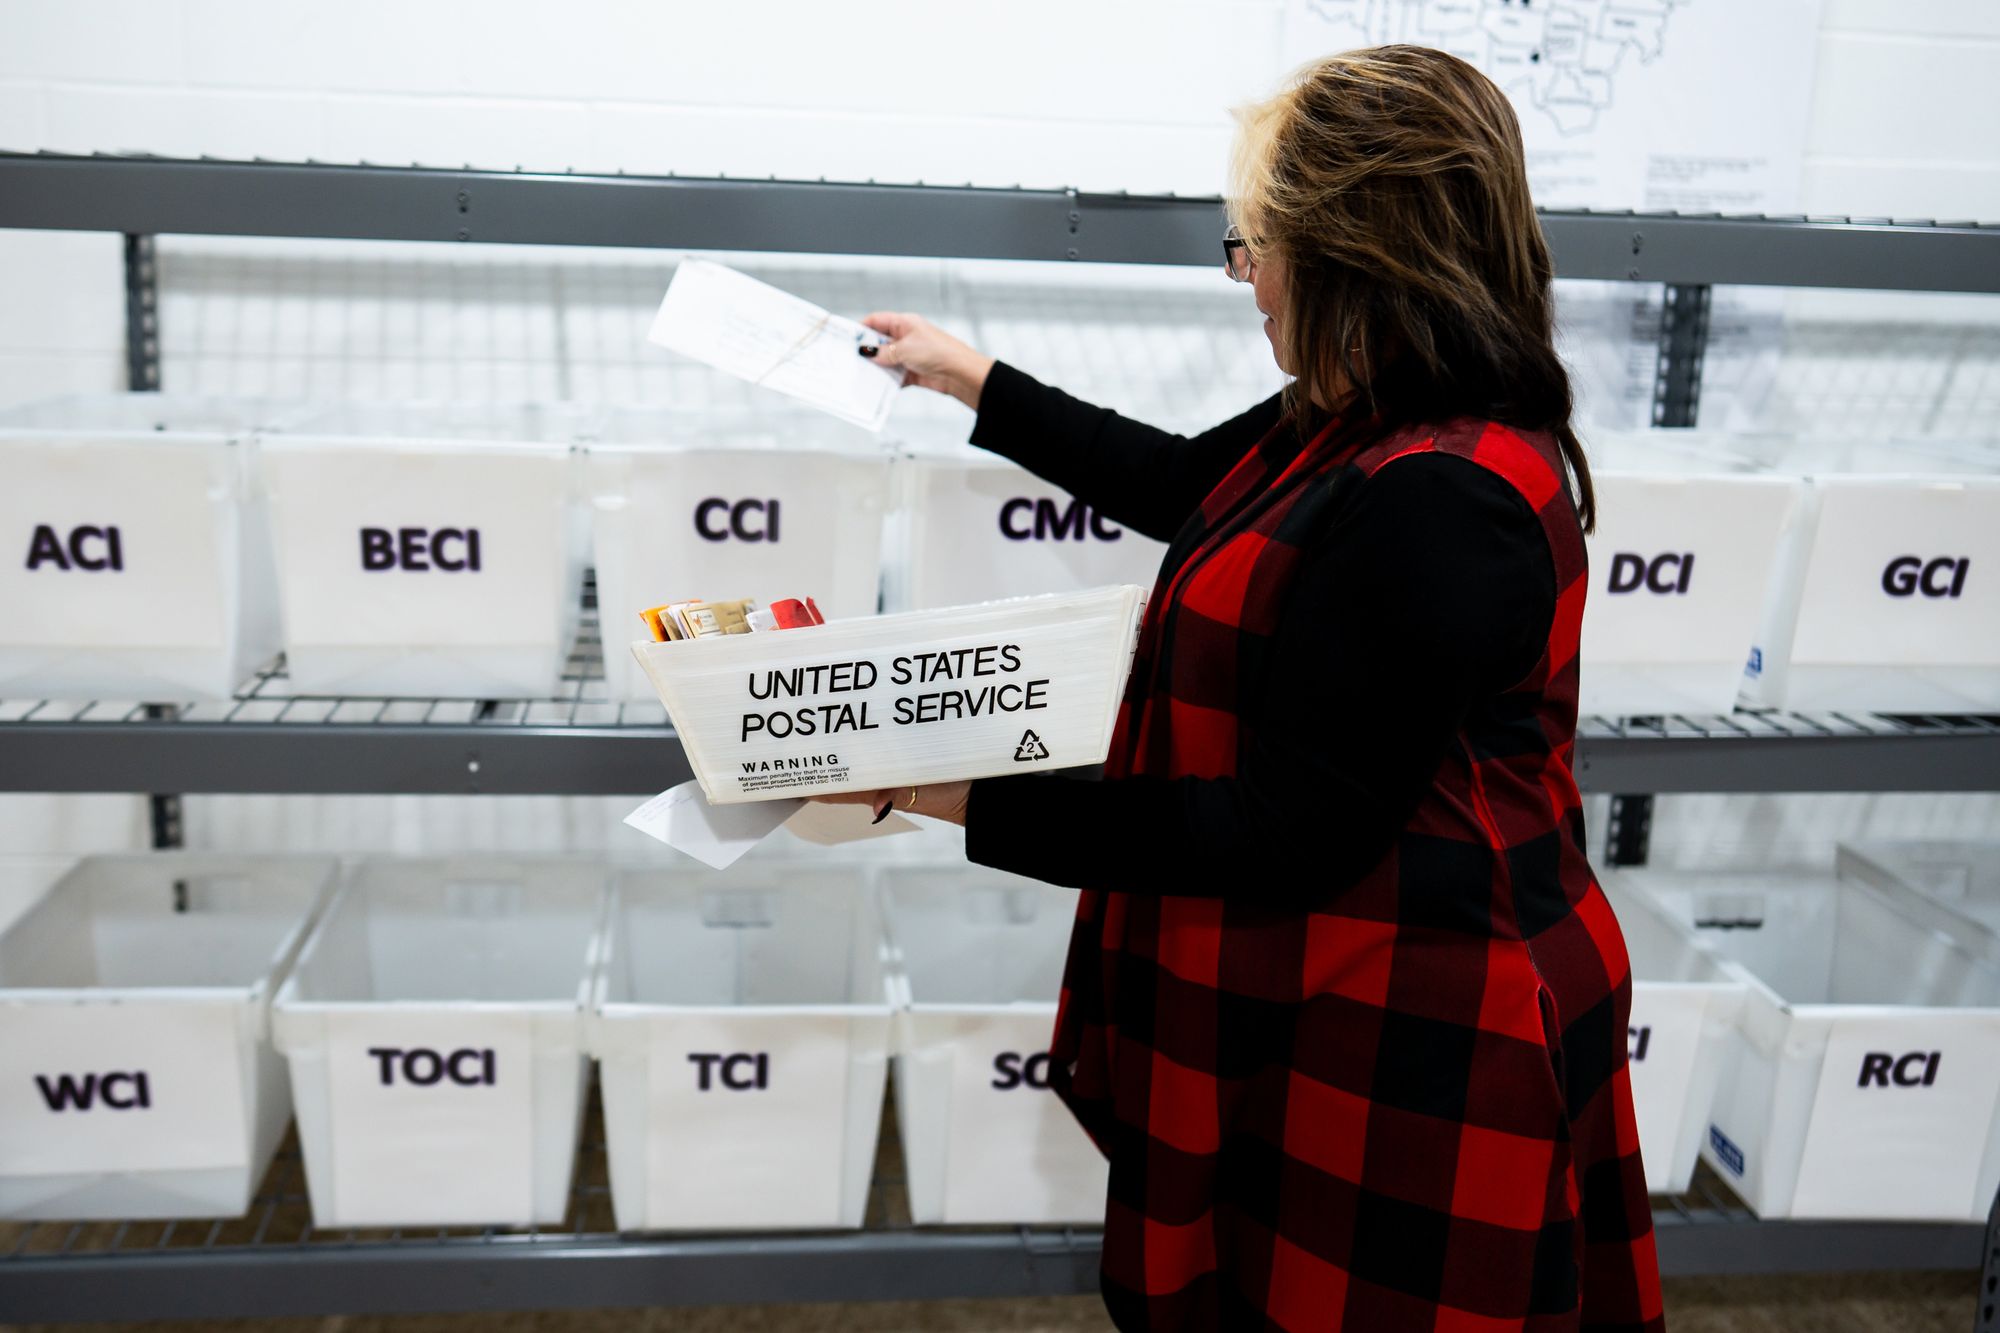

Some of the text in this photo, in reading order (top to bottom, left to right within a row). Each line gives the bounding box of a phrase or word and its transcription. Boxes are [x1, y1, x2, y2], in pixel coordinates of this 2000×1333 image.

[694, 497, 781, 543] CCI
[25, 524, 124, 572] ACI
[360, 527, 482, 572] BECI
[1607, 552, 1695, 595] DCI
[1881, 555, 1970, 598] GCI
[749, 644, 1021, 700] UNITED STATES
[741, 679, 1050, 742] POSTAL SERVICE
[742, 753, 839, 773] WARNING
[1026, 742, 1035, 753] 2
[738, 774, 768, 782] Maximum
[769, 772, 792, 780] penalty
[761, 782, 803, 790] imprisonment
[367, 1047, 497, 1087] TOCI
[687, 1052, 769, 1091] TCI
[1857, 1051, 1941, 1087] RCI
[34, 1071, 152, 1112] WCI
